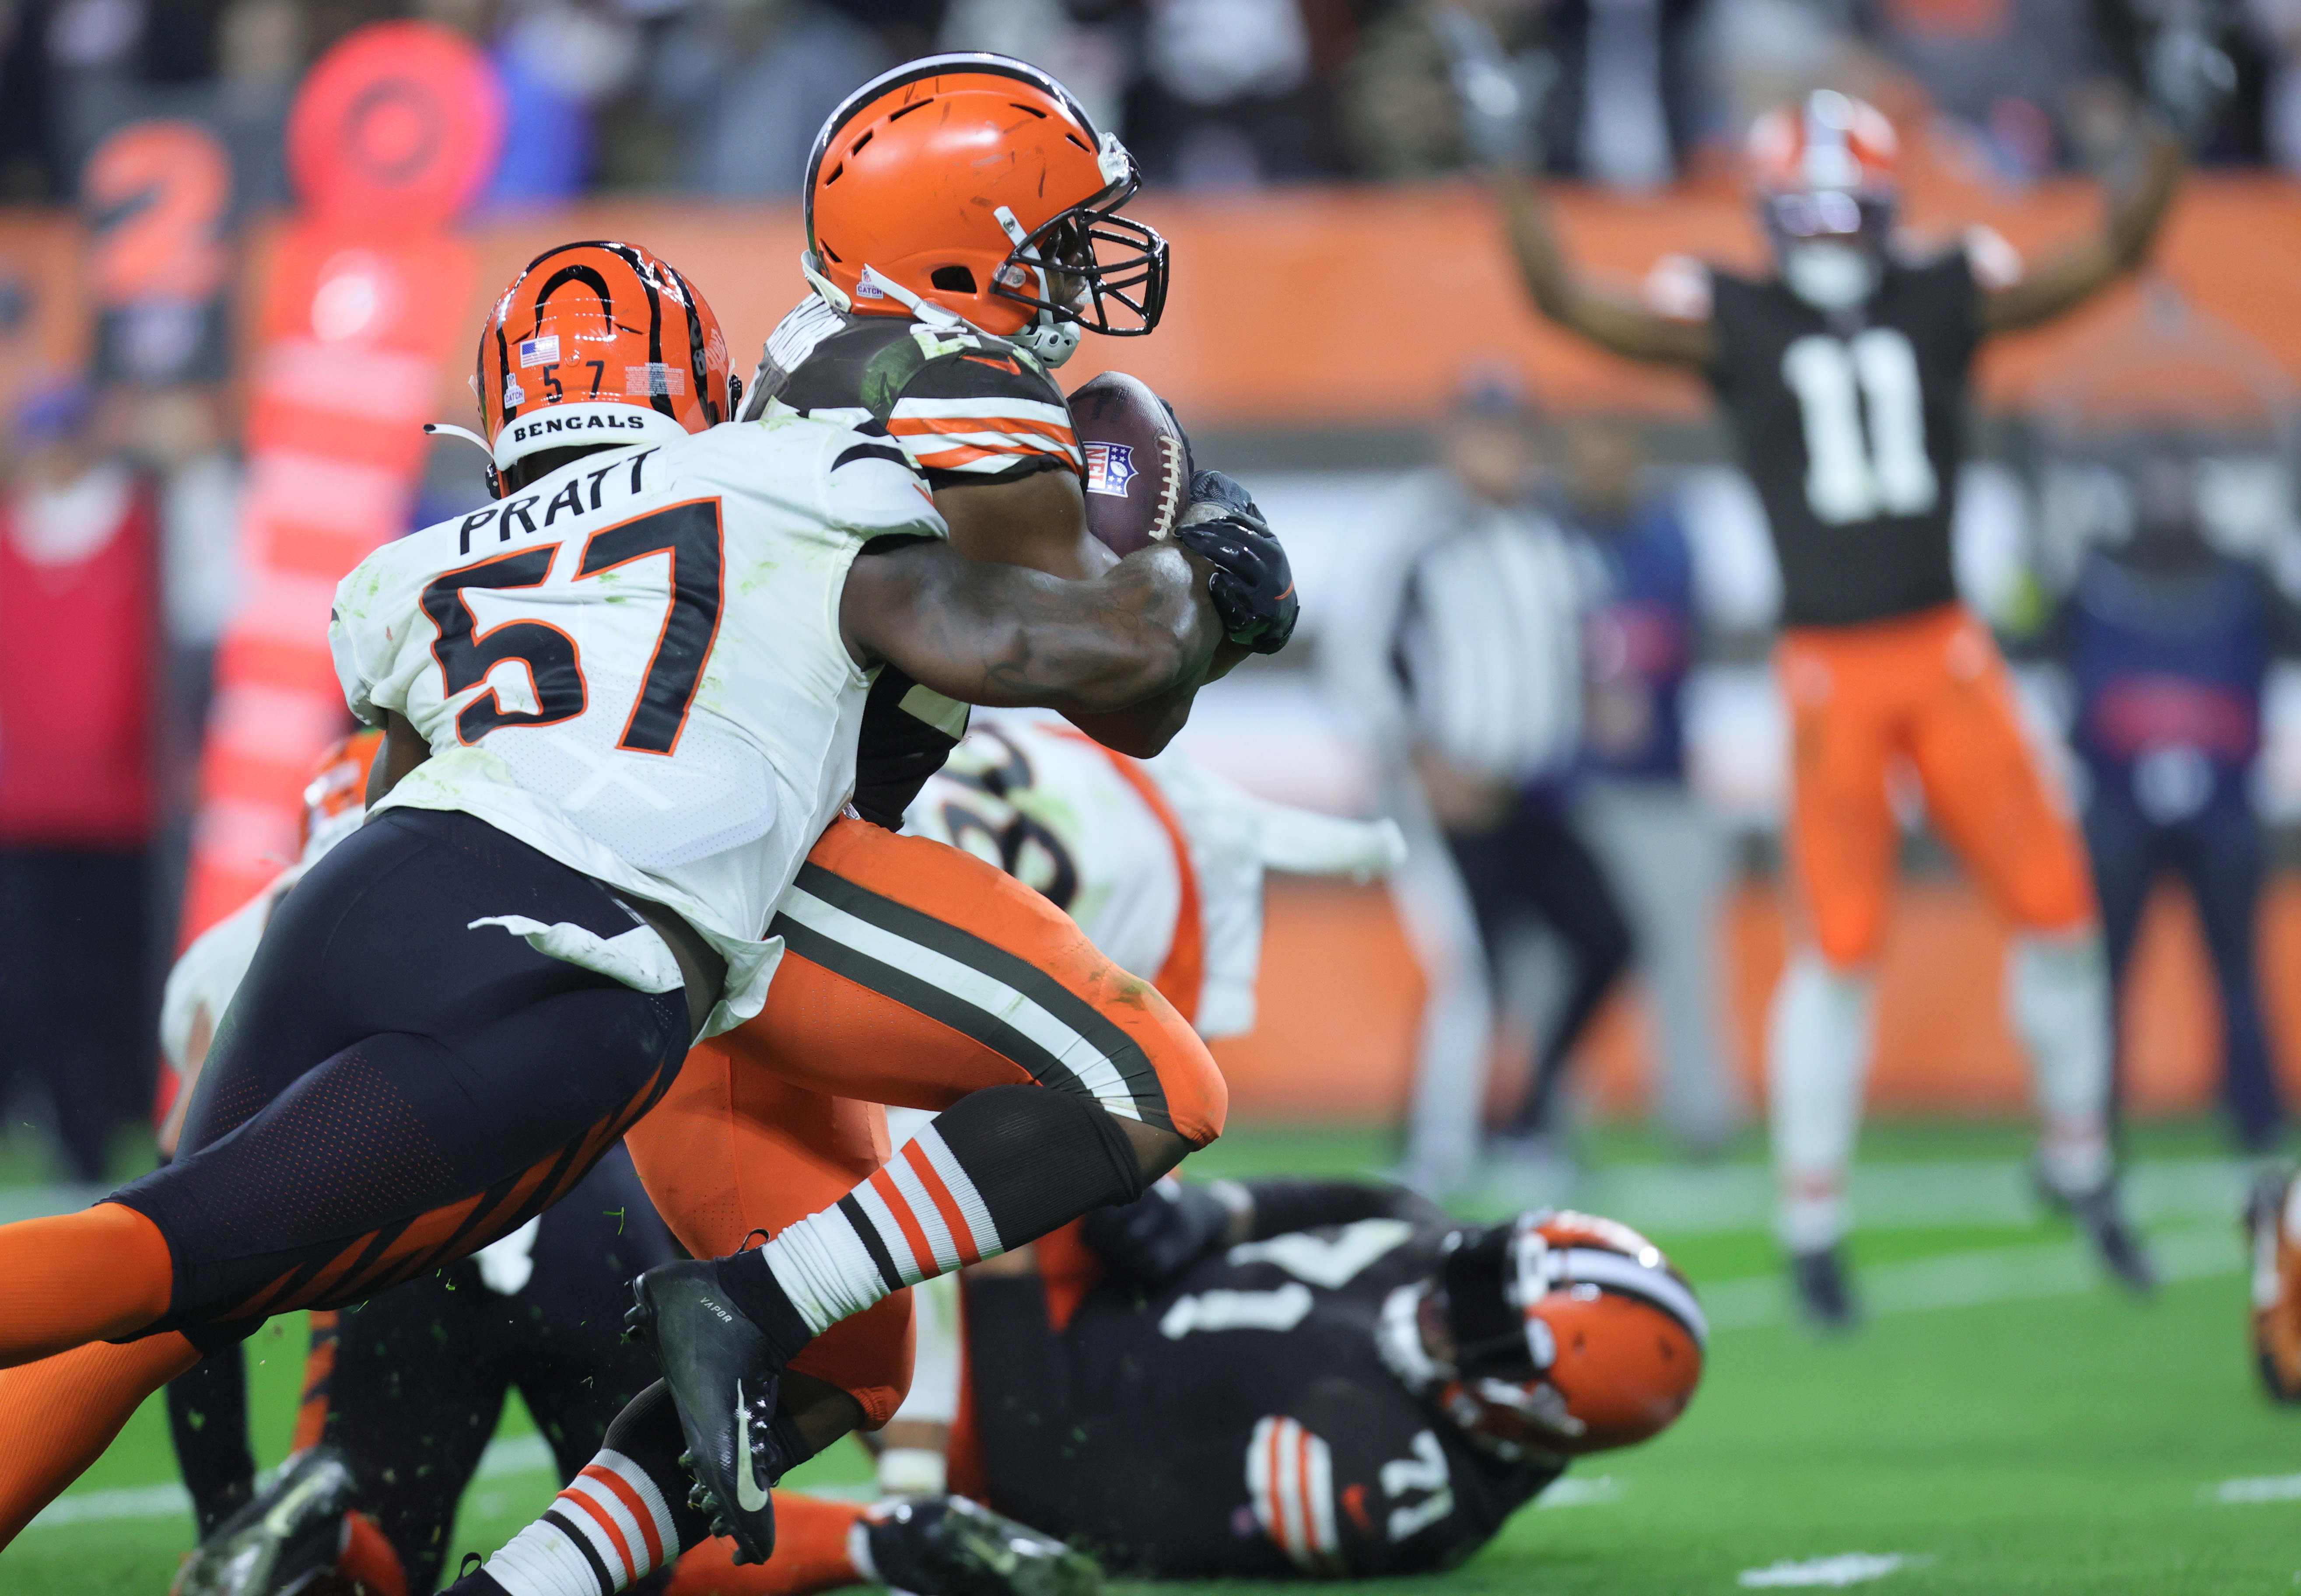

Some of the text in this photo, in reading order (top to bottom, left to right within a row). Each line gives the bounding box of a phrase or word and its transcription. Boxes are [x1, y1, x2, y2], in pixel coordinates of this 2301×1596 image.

[858, 286, 882, 294] CATCH
[506, 390, 523, 403] CATCH
[514, 415, 644, 442] BENGALS
[1780, 328, 1939, 524] 11
[459, 446, 661, 556] PRATT
[419, 495, 725, 757] 57
[700, 1297, 732, 1323] VAPOR
[1379, 1429, 1454, 1540] 12
